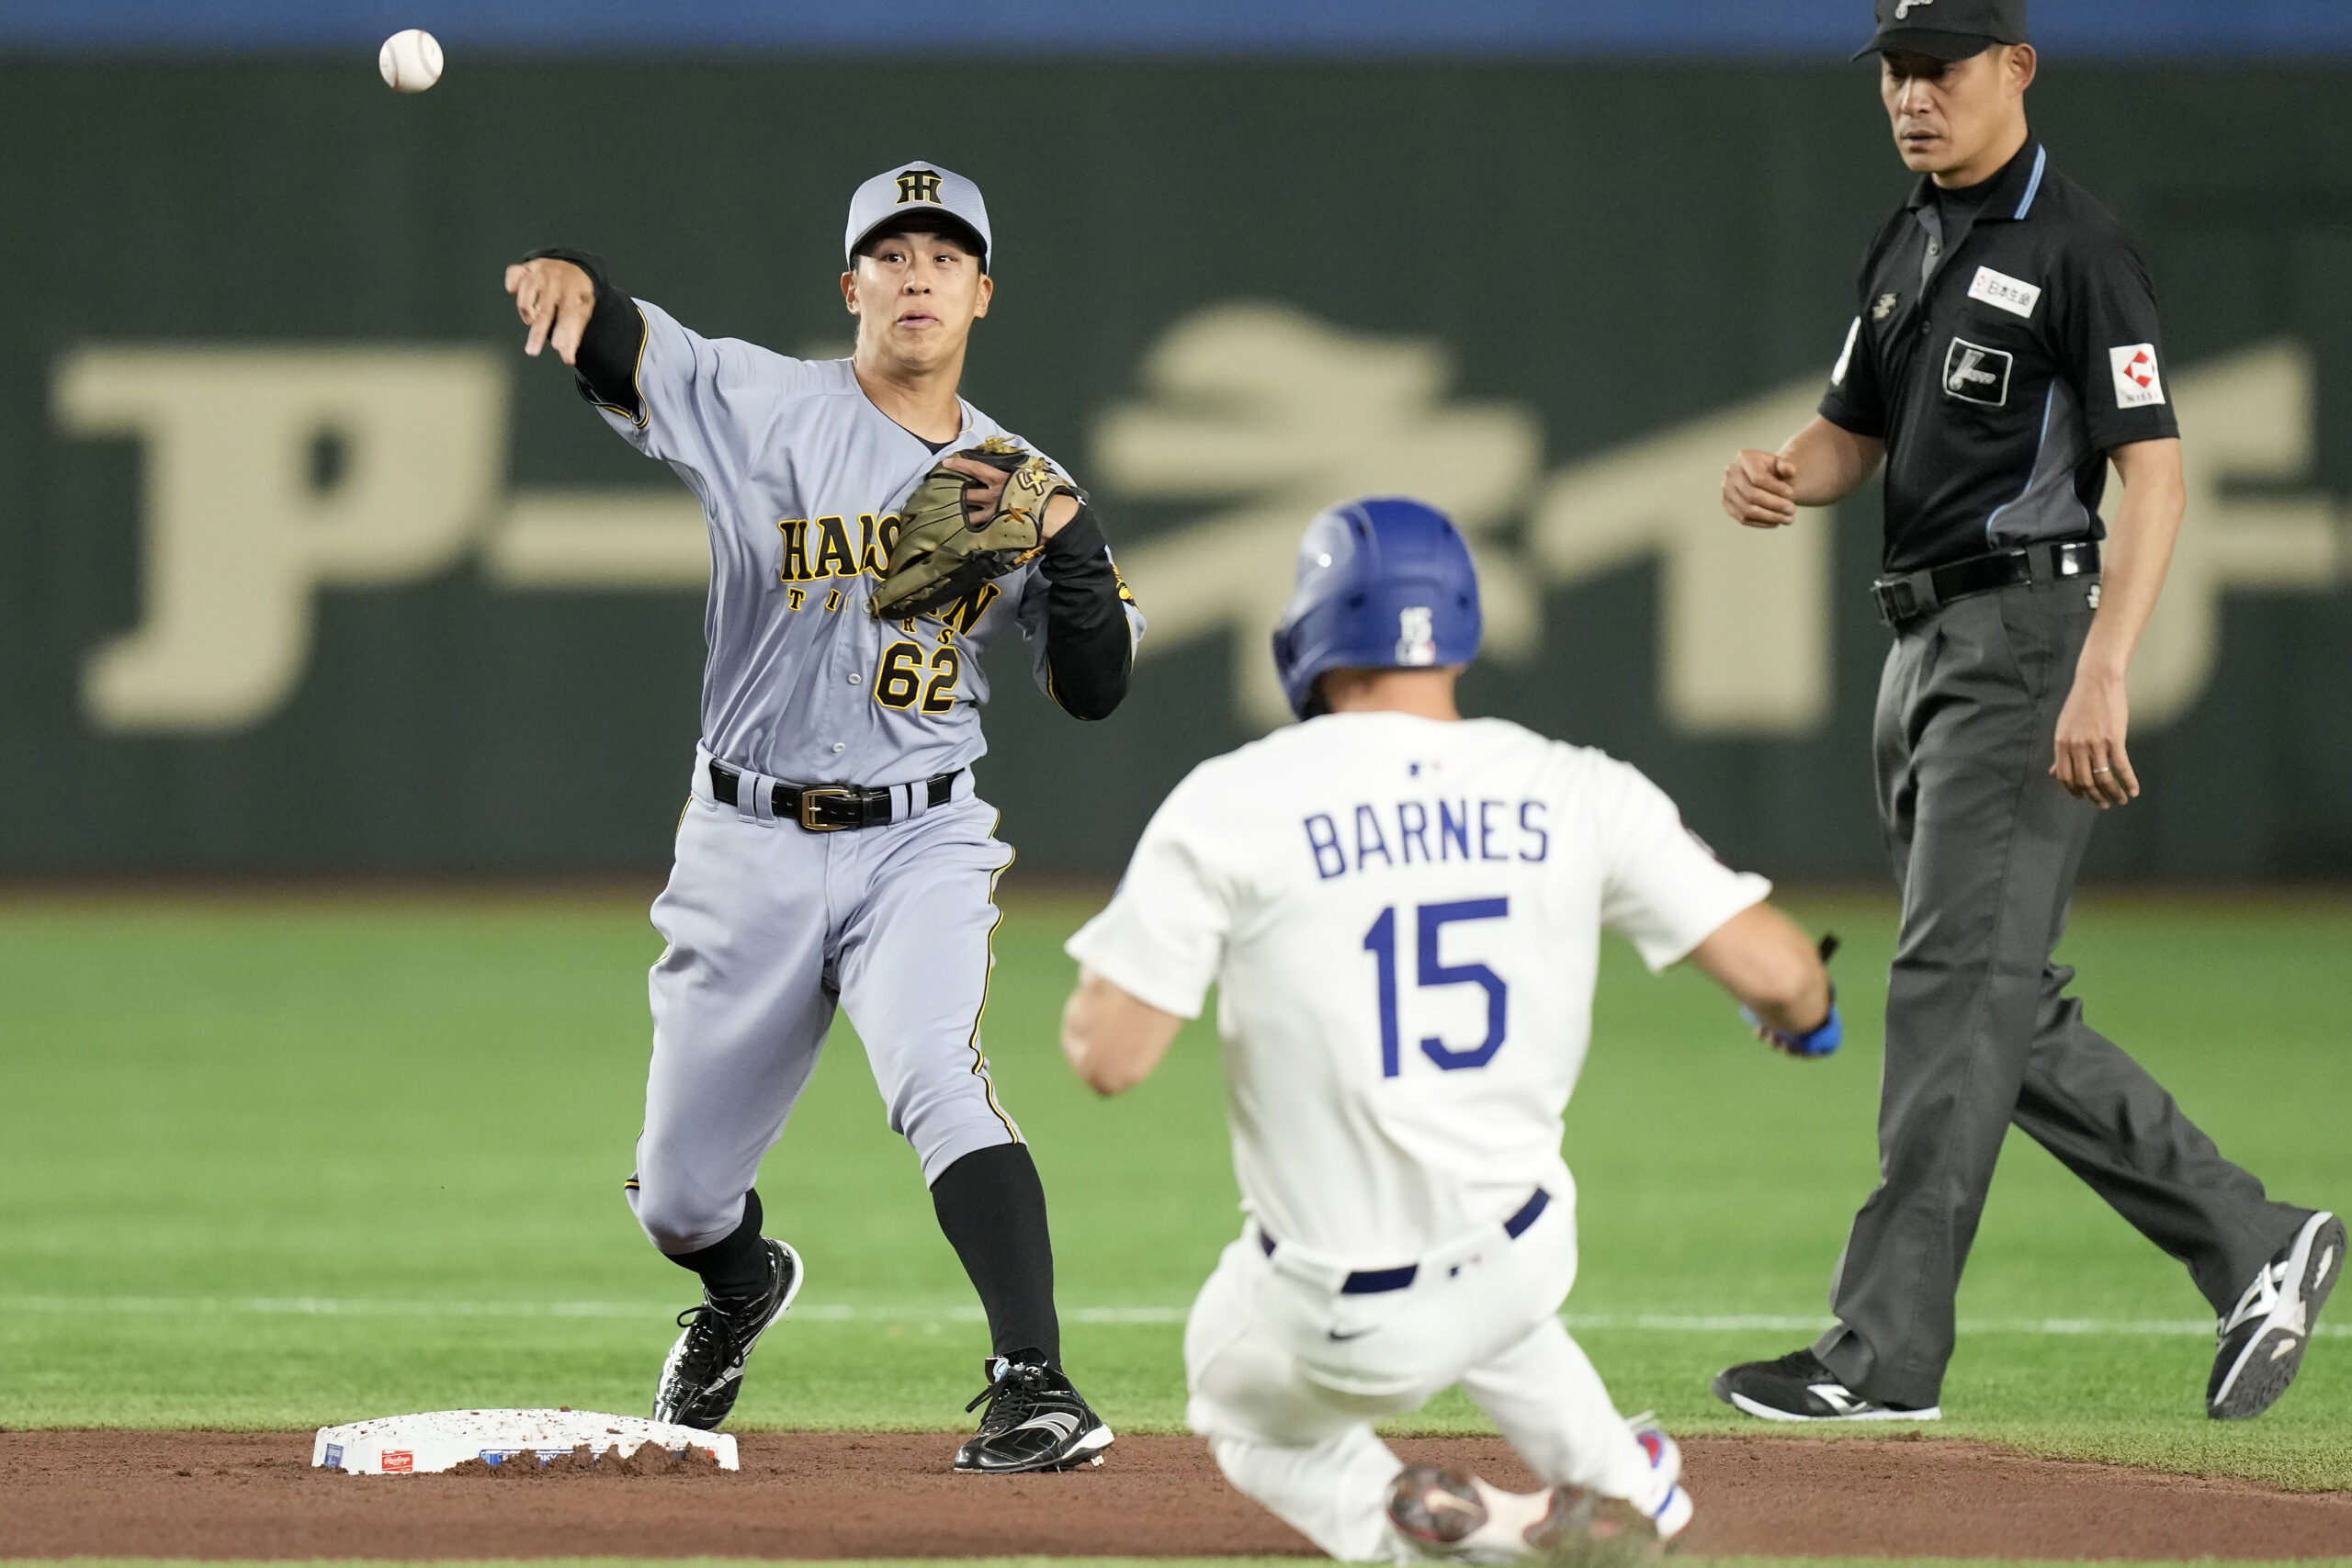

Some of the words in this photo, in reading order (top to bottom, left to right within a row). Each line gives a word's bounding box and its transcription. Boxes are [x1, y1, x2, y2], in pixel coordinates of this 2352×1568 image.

[1987, 279, 2031, 307] 日本生命
[874, 640, 960, 714] 62
[1303, 796, 1549, 879] BARNES
[1363, 896, 1510, 1078] 15
